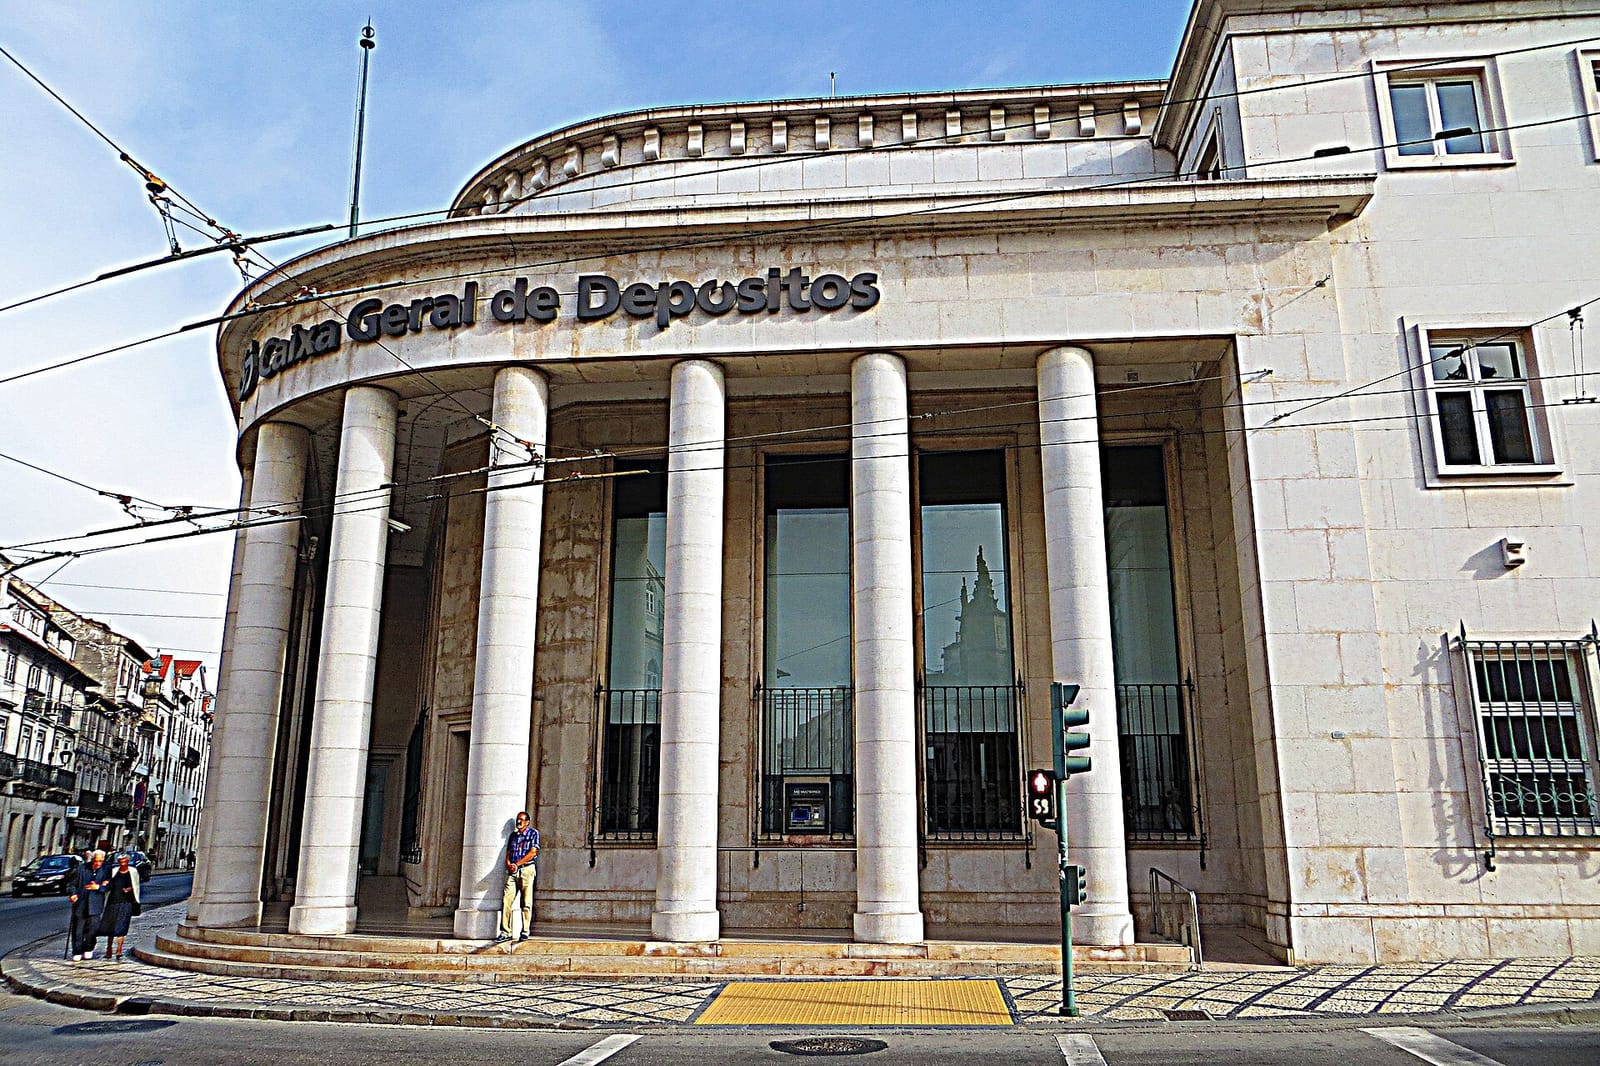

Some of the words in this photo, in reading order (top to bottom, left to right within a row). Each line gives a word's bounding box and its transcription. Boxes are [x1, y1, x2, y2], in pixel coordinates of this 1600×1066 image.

[261, 320, 342, 379] Caixa
[346, 281, 479, 343] Geral
[491, 277, 561, 323] de
[577, 266, 881, 330] Depositos
